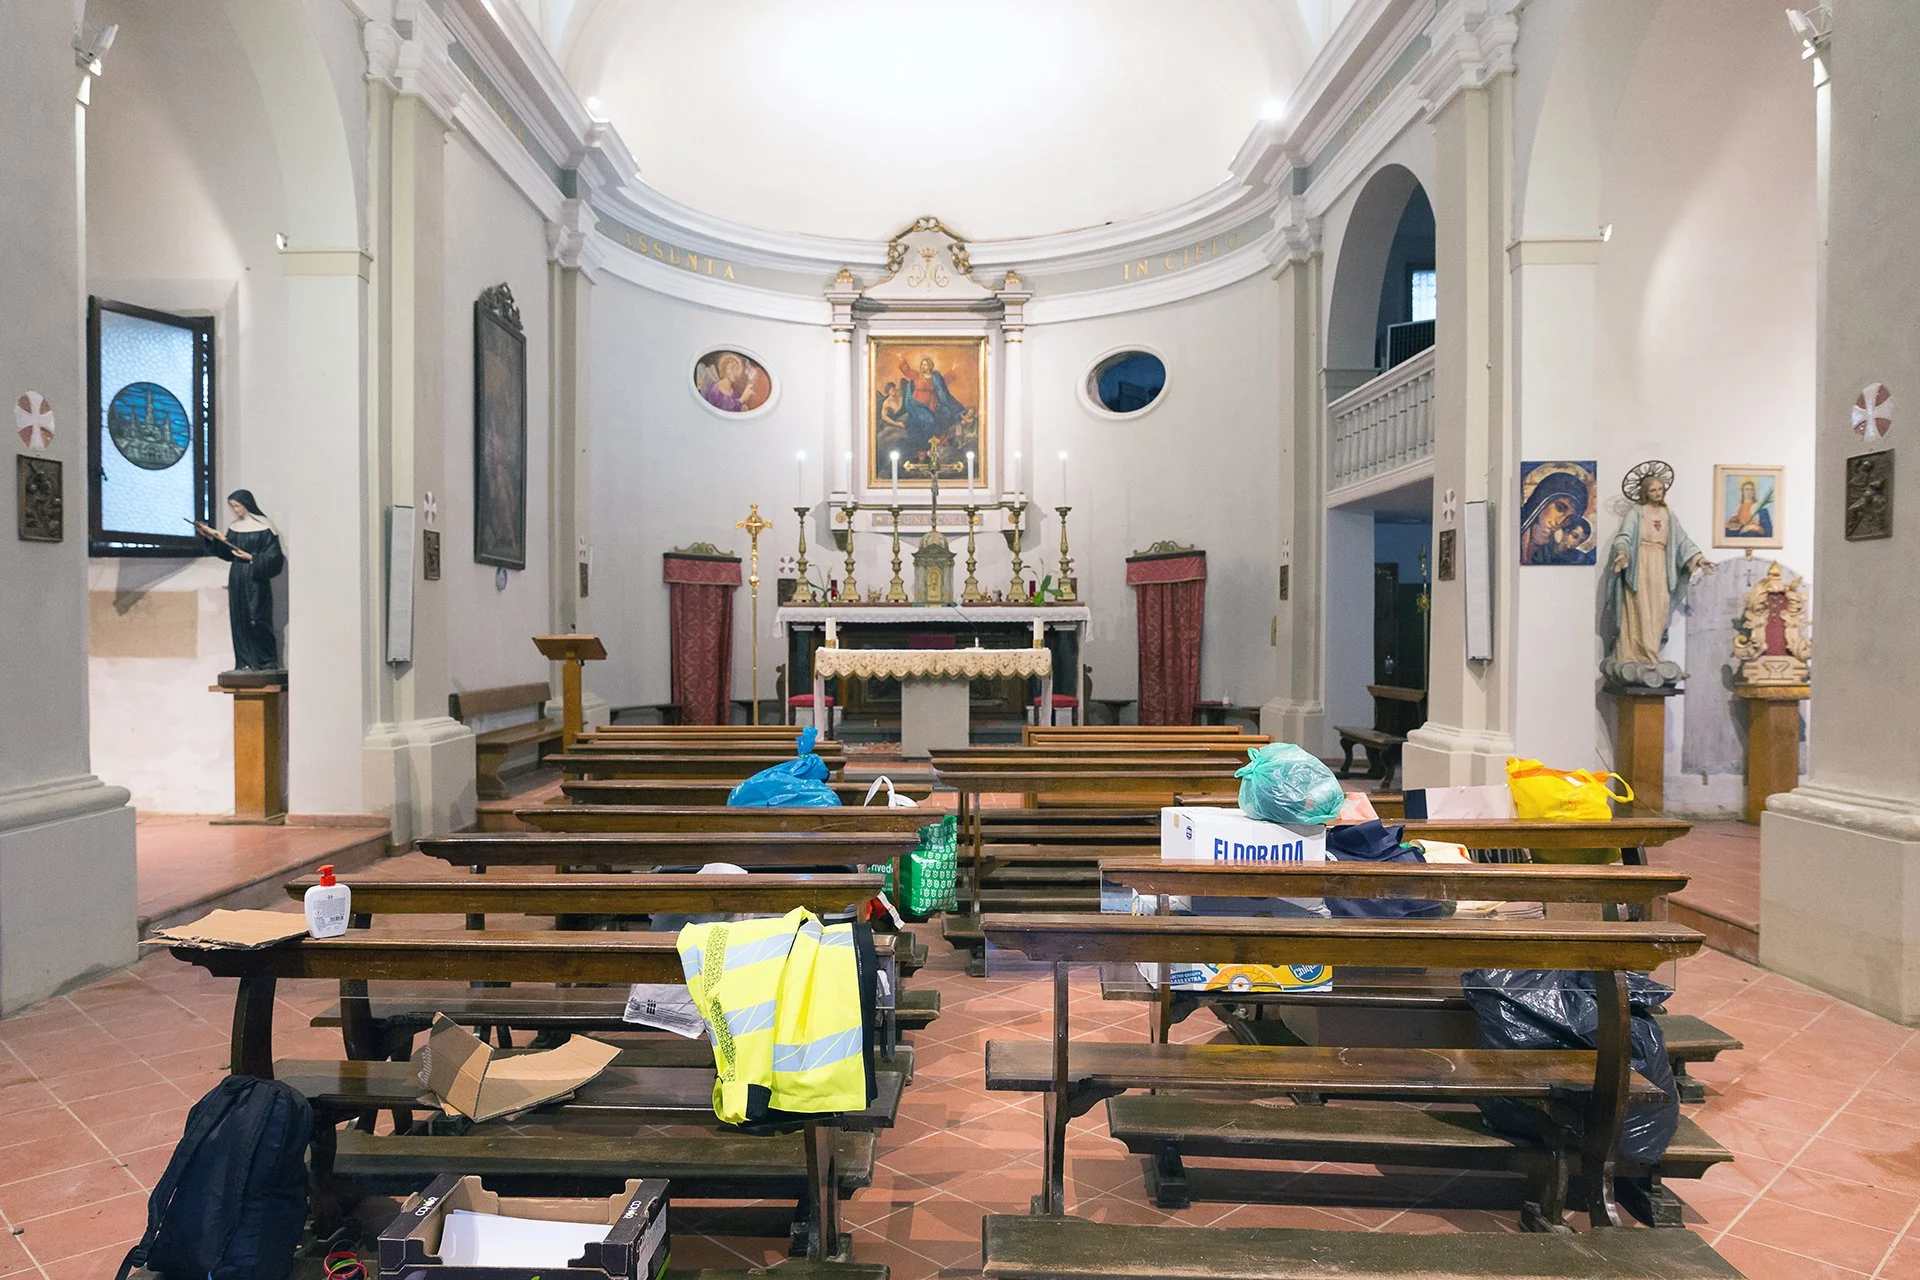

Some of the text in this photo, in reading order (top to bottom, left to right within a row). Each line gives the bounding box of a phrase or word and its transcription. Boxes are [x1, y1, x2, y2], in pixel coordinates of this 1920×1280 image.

[624, 232, 736, 279] ASSUNTA
[1123, 233, 1240, 279] IN CIELO
[1293, 965, 1318, 978] Chiqu
